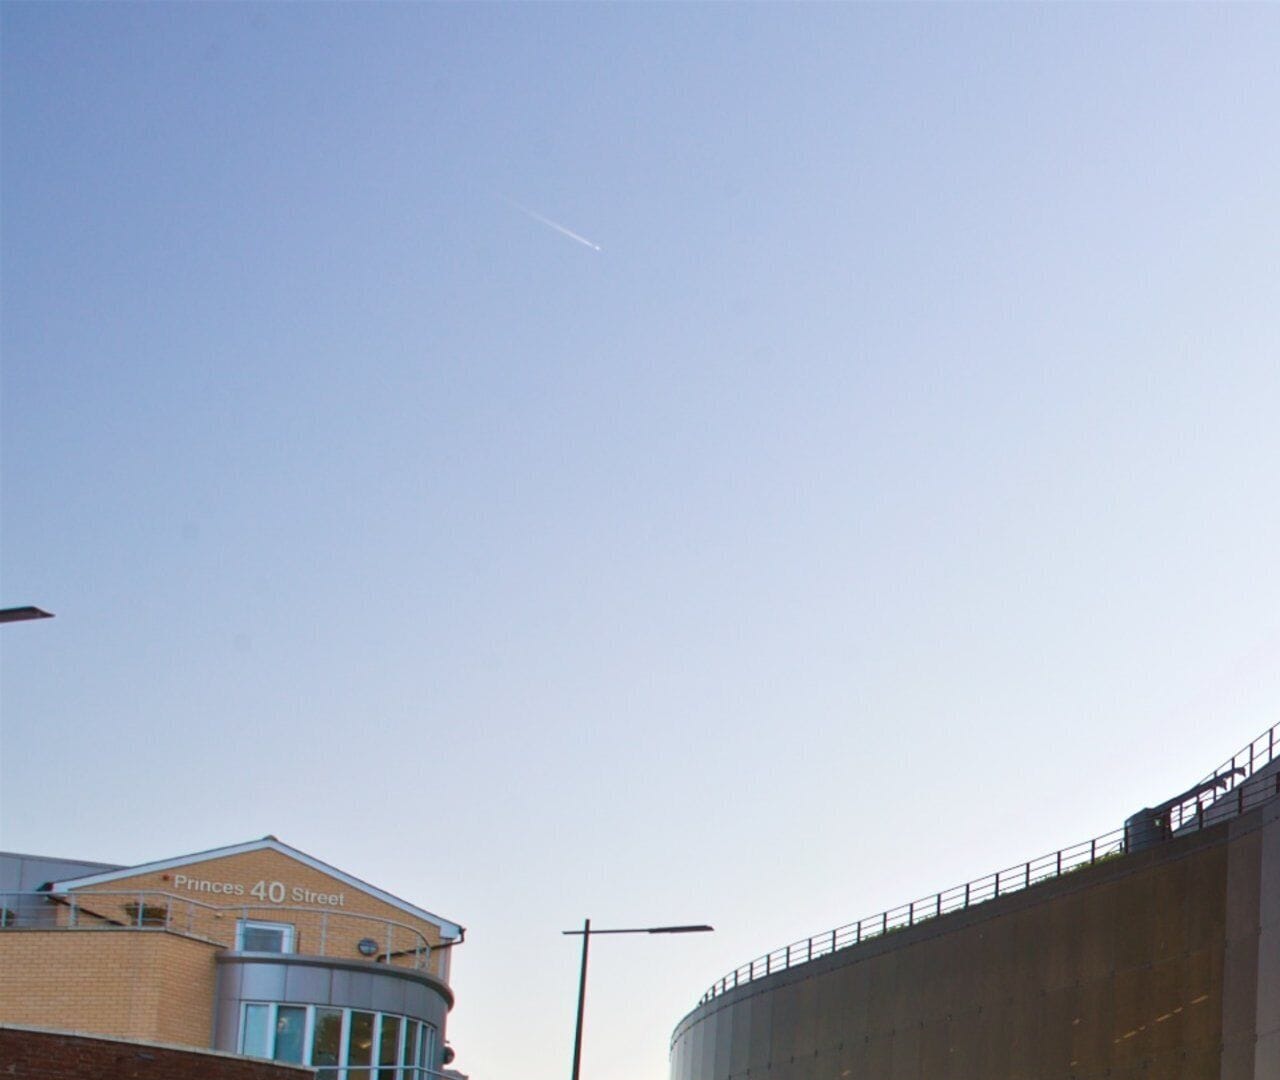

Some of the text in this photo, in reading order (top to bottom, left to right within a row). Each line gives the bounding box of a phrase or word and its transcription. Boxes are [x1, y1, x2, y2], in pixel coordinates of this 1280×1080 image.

[174, 874, 345, 906] Princes 40 Street
